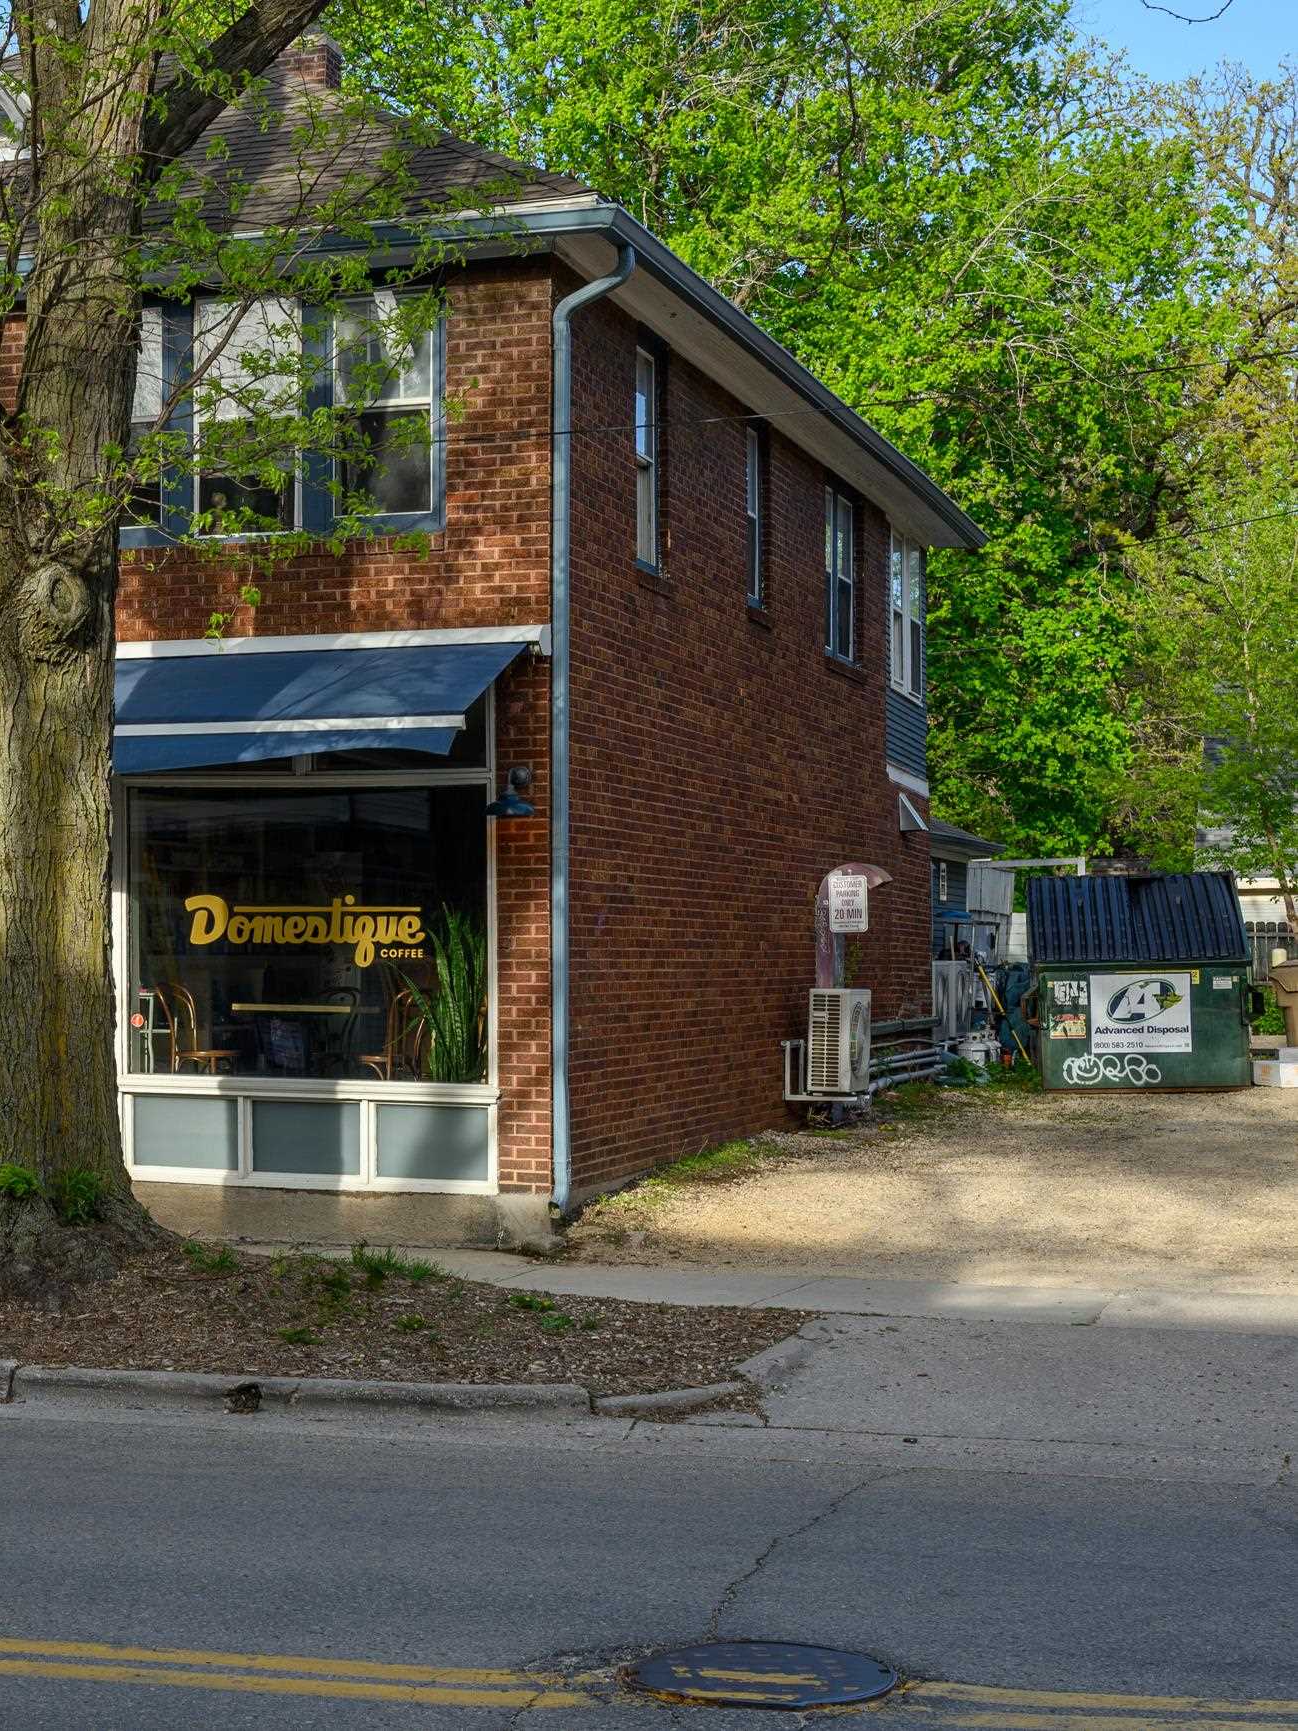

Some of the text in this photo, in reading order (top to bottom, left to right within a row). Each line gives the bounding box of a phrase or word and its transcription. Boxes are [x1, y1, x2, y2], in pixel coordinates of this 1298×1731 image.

[835, 889, 860, 898] PARKING
[834, 908, 863, 920] 20 MIN
[184, 894, 426, 968] Domestique
[380, 949, 424, 959] COFFEE
[1094, 1025, 1144, 1035] Advanced
[1146, 1024, 1189, 1035] Disposal
